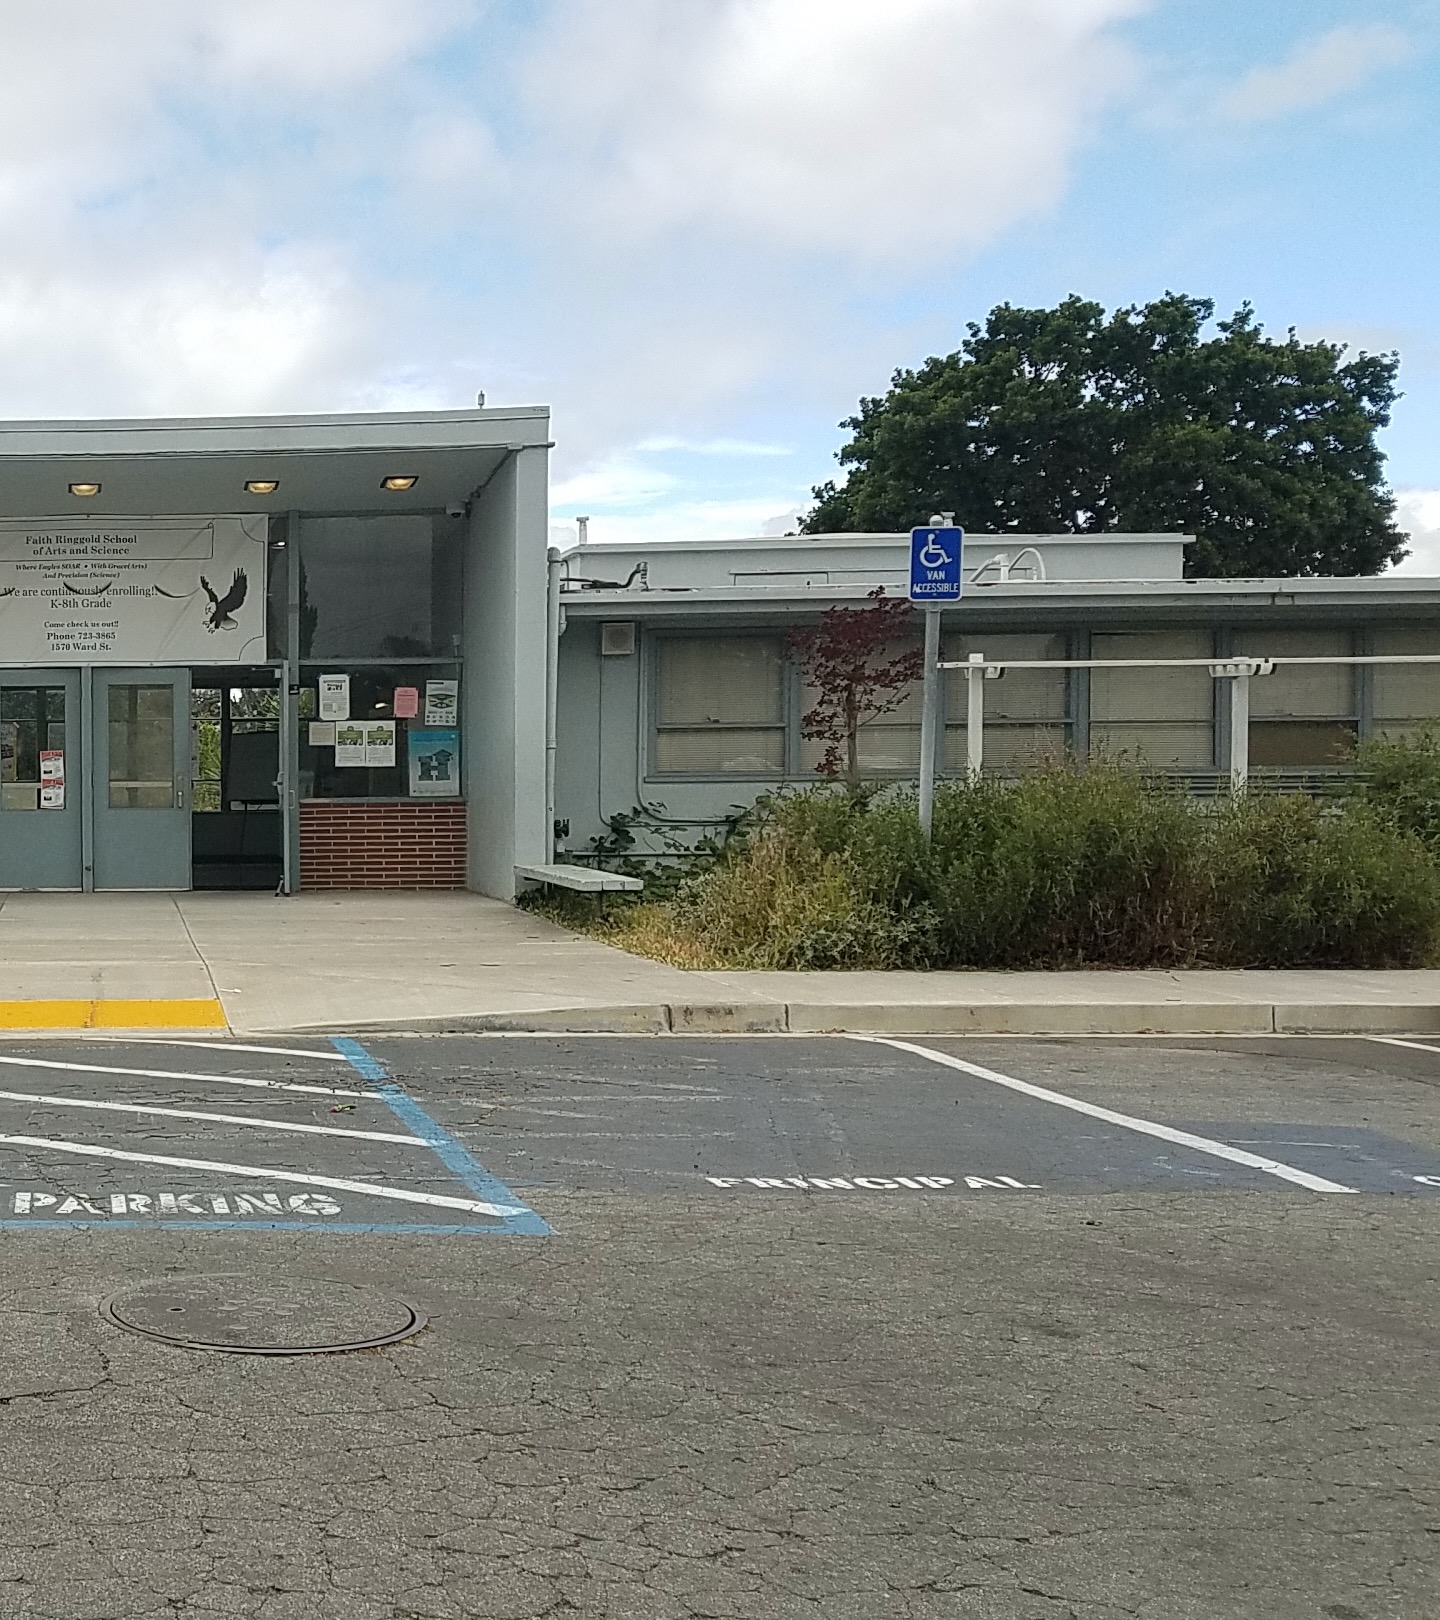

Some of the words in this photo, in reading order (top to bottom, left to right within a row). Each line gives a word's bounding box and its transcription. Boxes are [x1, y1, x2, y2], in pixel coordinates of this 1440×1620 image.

[25, 535, 52, 545] Faith
[55, 535, 100, 545] Ringgold
[103, 535, 137, 544] School
[33, 546, 43, 555] of
[45, 547, 66, 555] Arts
[69, 546, 88, 554] and
[90, 546, 129, 554] Science
[926, 570, 946, 580] VAN
[3, 587, 20, 597] We
[22, 589, 38, 597] are
[40, 586, 103, 598] continuously
[912, 582, 959, 593] ACCESSIBLE
[50, 599, 78, 608] K-8th
[81, 599, 112, 608] Grade
[47, 632, 75, 640] Phone
[77, 632, 116, 640] 723-3865
[51, 643, 71, 651] 1570
[72, 642, 97, 651] Ward
[99, 643, 112, 651] St.
[705, 1176, 1043, 1190] PRINCIPAL
[13, 1191, 343, 1216] PARKING
